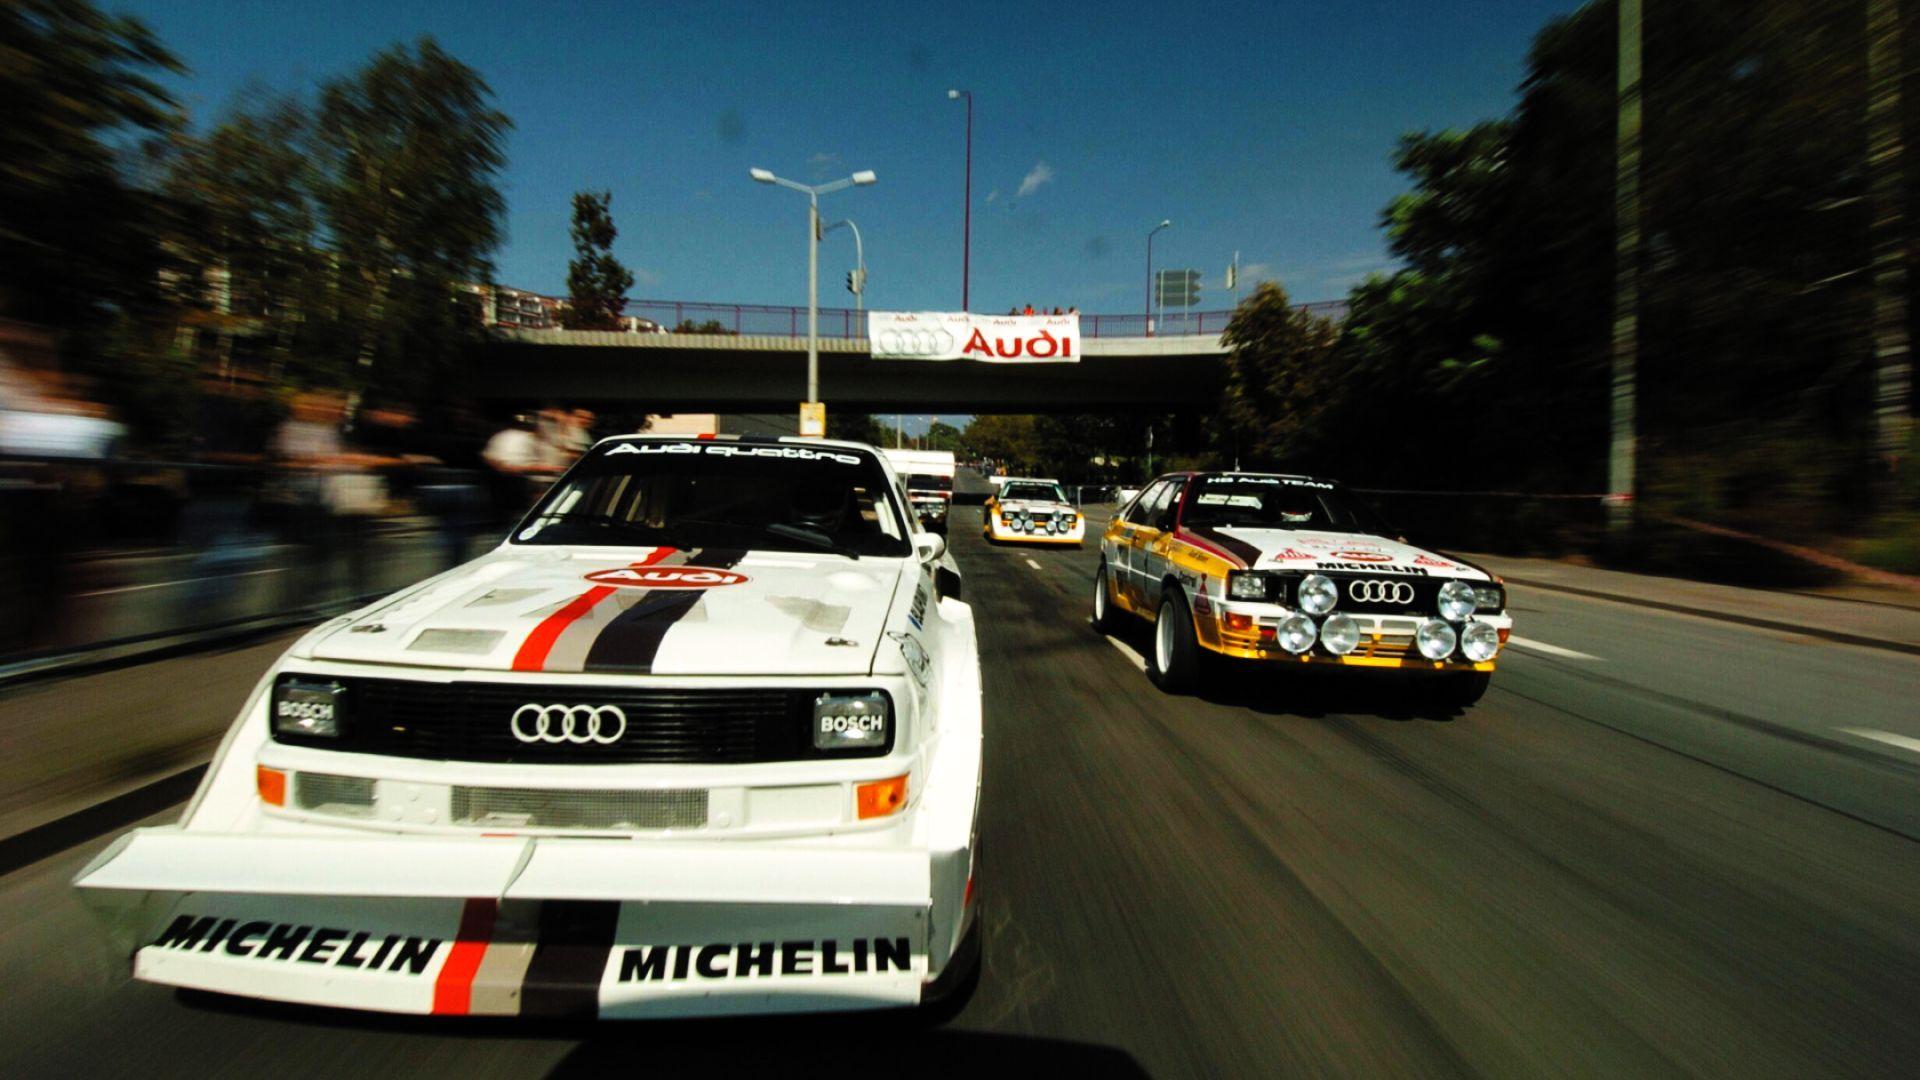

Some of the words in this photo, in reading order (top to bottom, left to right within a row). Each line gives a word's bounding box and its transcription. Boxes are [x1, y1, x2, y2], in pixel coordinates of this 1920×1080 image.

[962, 327, 1071, 358] Audi
[705, 446, 861, 465] quattro
[1281, 479, 1334, 489] TEAM
[590, 568, 739, 584] Audi
[1316, 562, 1428, 576] MICHELIN
[278, 701, 335, 719] BOSCH
[821, 715, 883, 732] BOSCH
[152, 914, 442, 975] MICHELIN
[618, 937, 911, 983] MICHELIN
